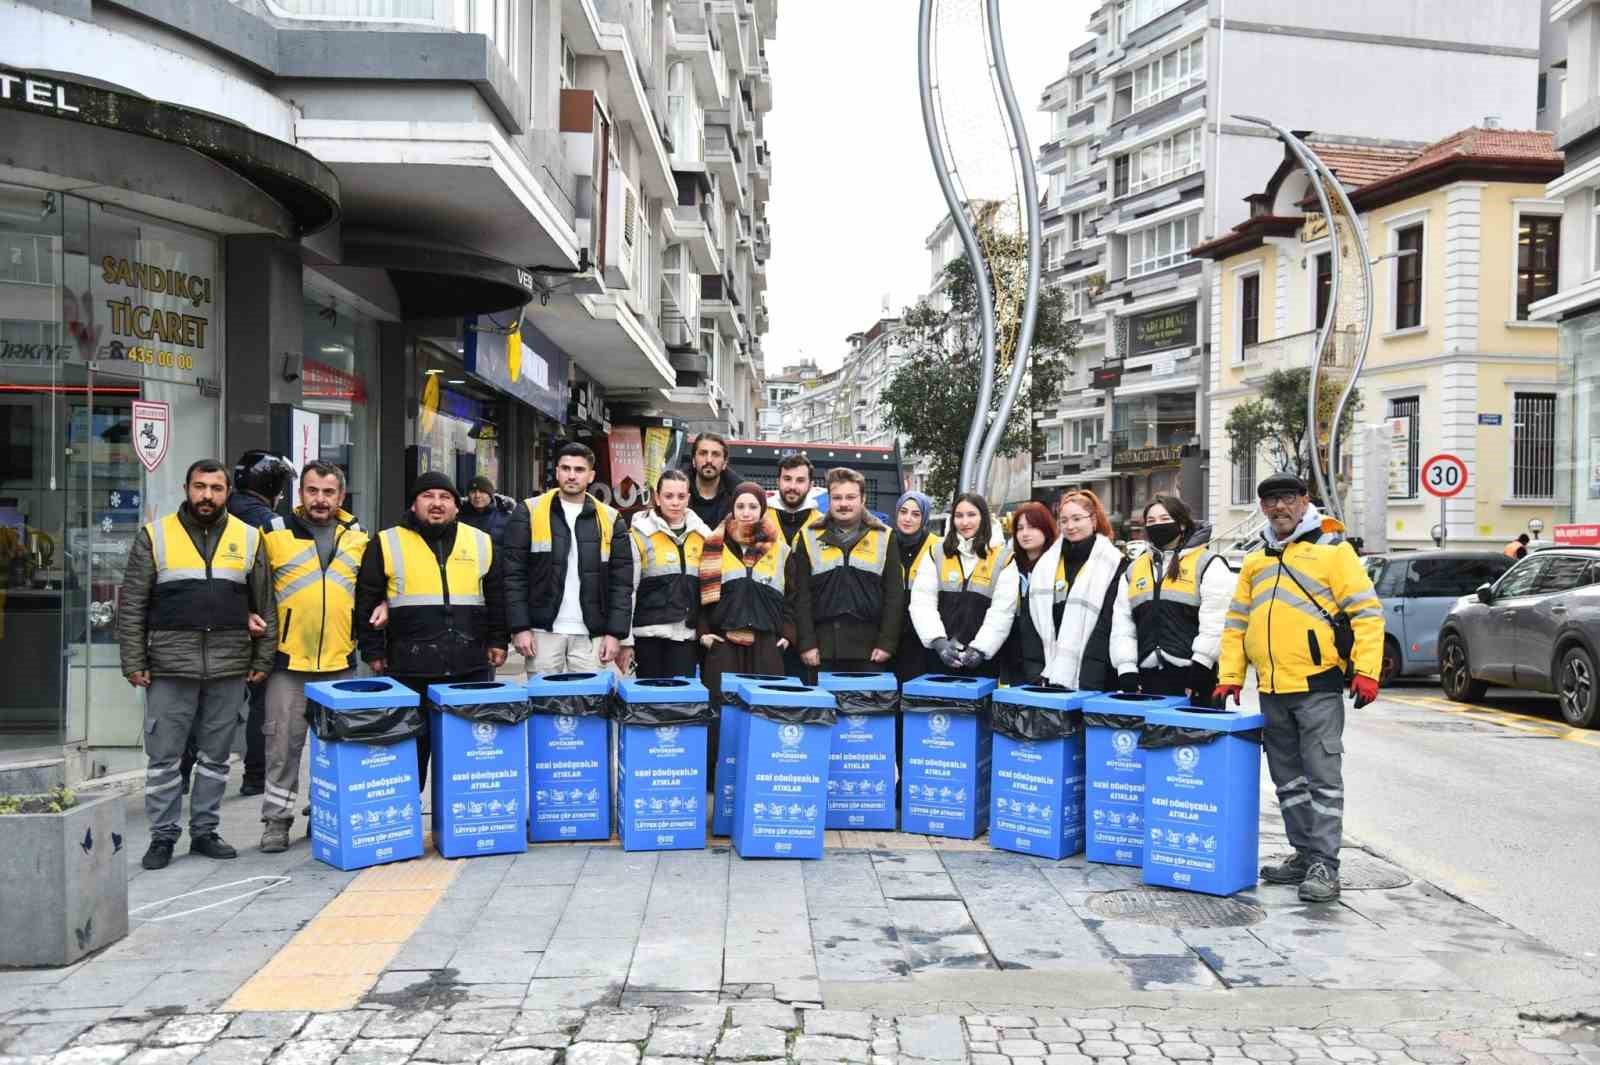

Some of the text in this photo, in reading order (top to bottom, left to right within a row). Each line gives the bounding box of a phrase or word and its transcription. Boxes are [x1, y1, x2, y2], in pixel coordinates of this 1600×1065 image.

[0, 73, 79, 112] TEL
[102, 256, 211, 307] SANDIKÇI
[107, 296, 208, 349] TİCARET
[127, 345, 153, 364] 435
[1431, 466, 1458, 486] 30
